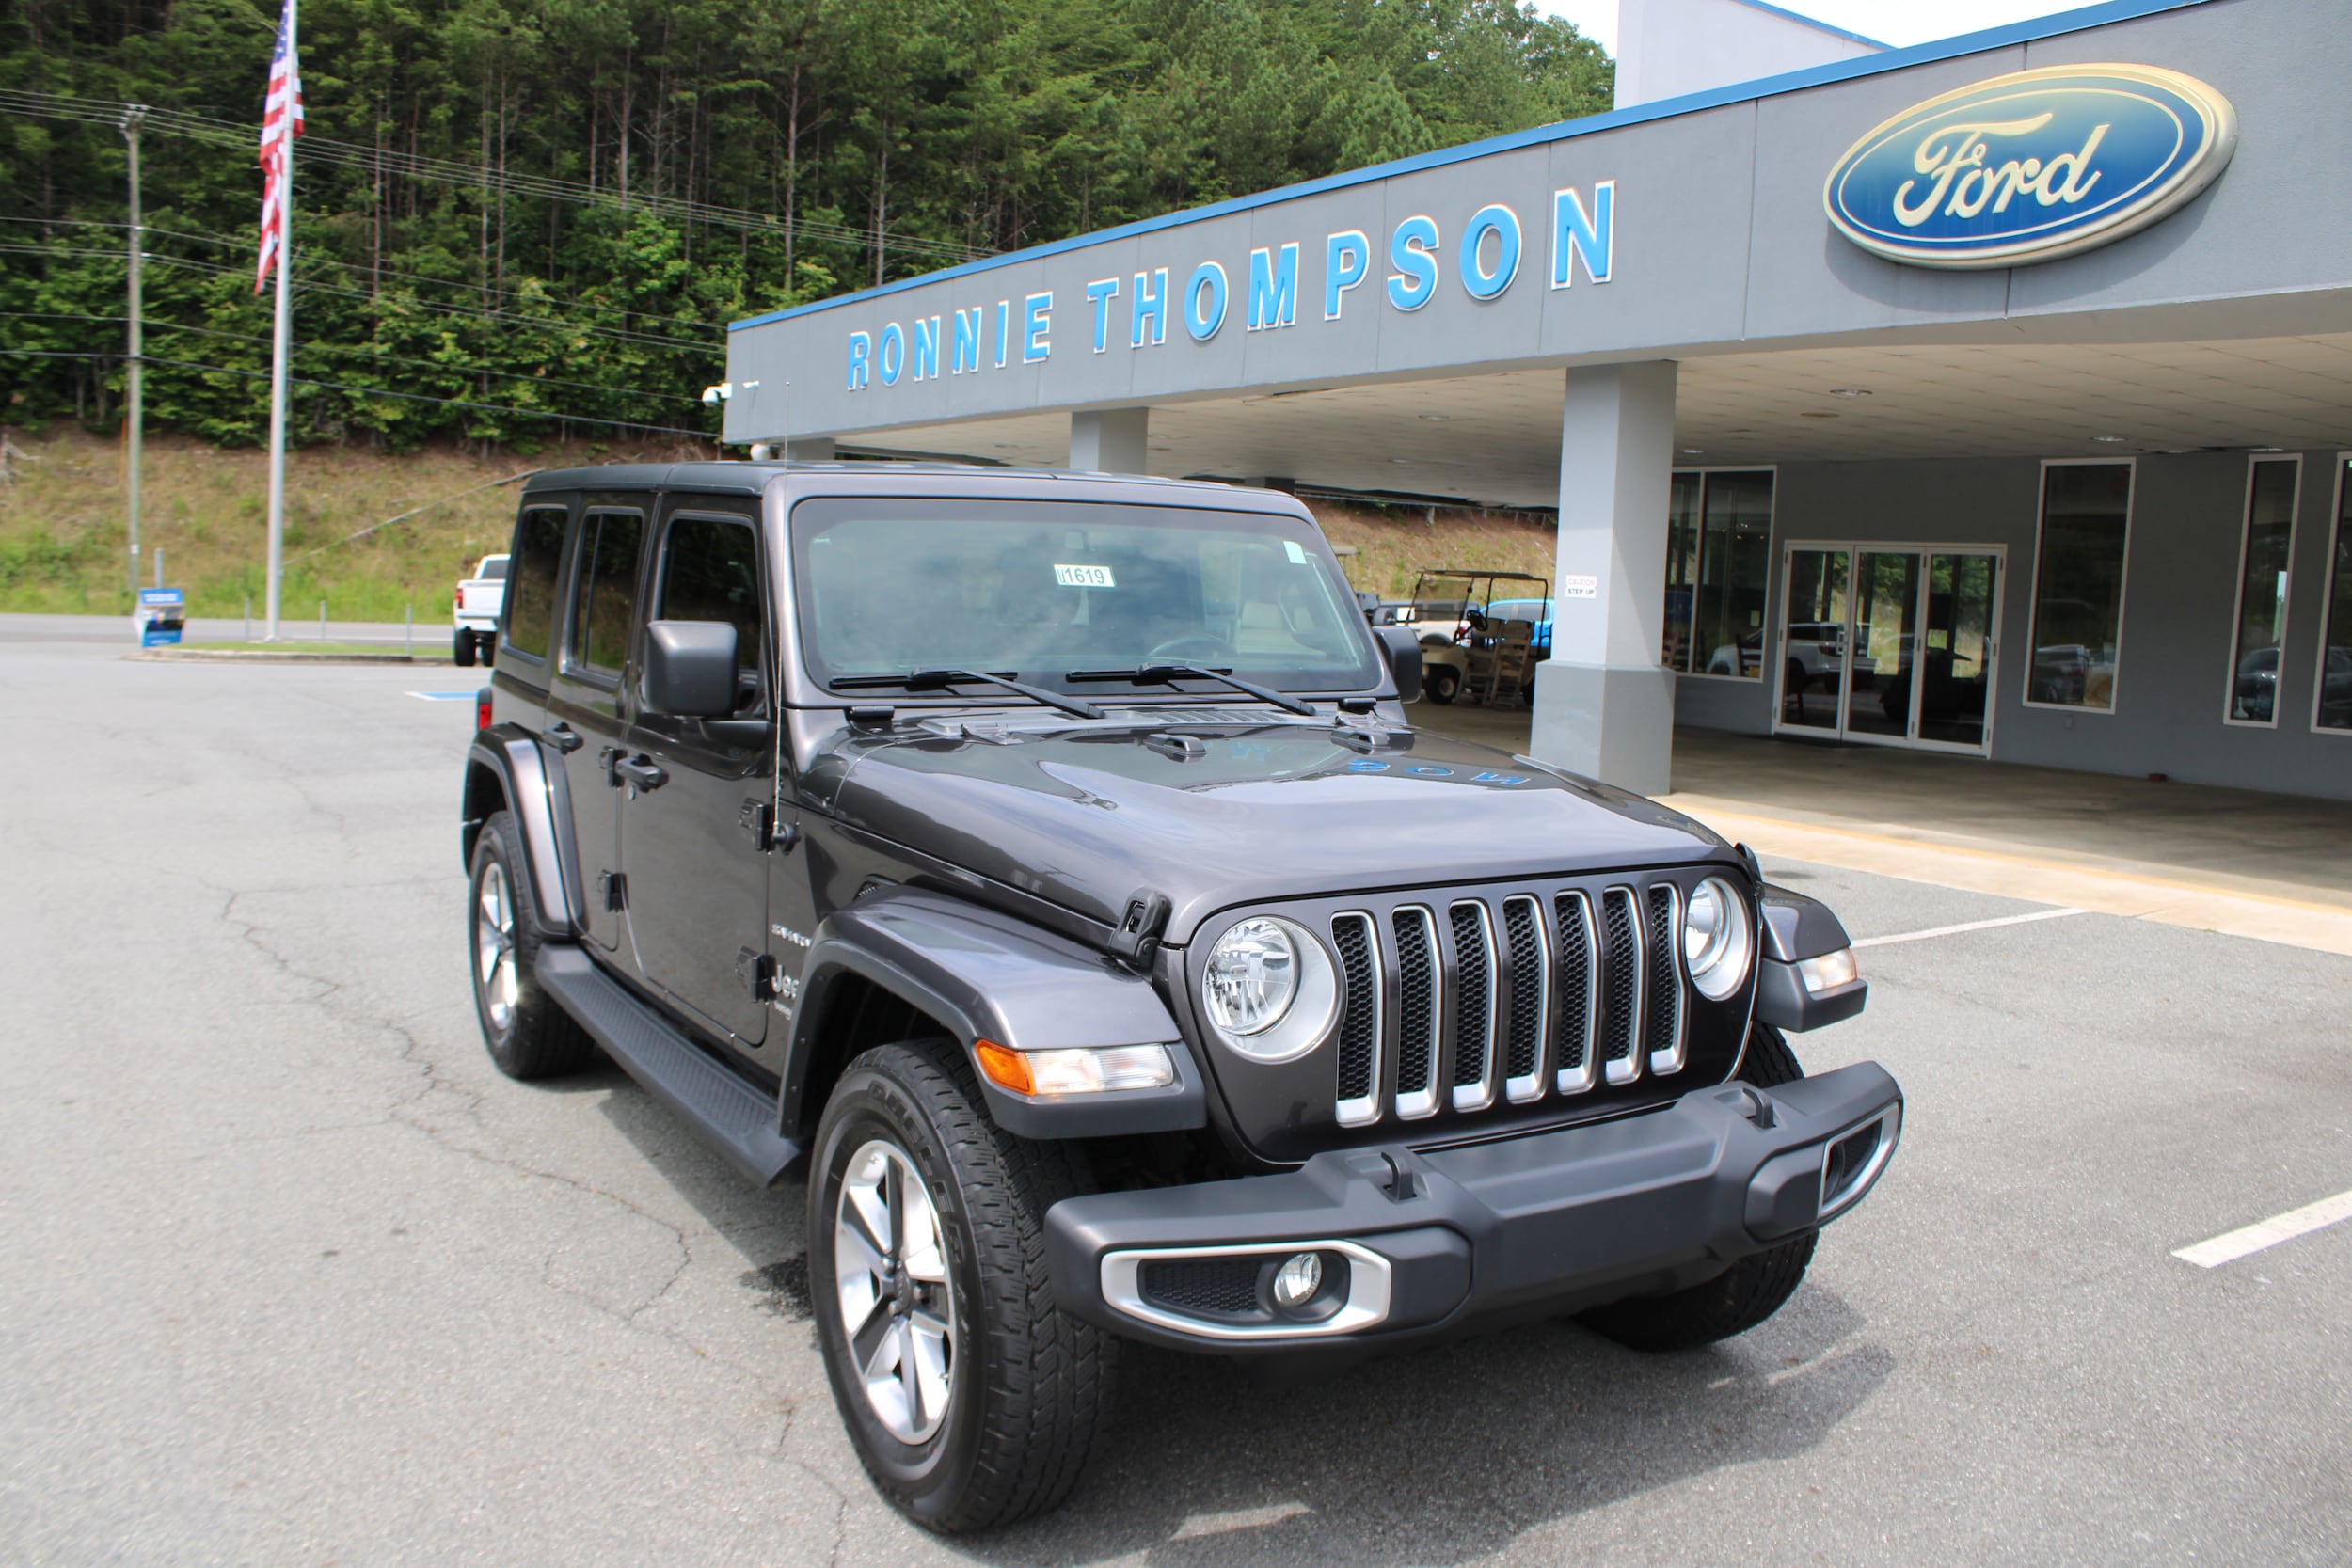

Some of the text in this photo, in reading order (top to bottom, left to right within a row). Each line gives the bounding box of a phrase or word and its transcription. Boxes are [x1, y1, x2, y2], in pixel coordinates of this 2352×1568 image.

[1893, 112, 2111, 228] Ford
[847, 179, 1616, 391] RONNIE THOMPSON
